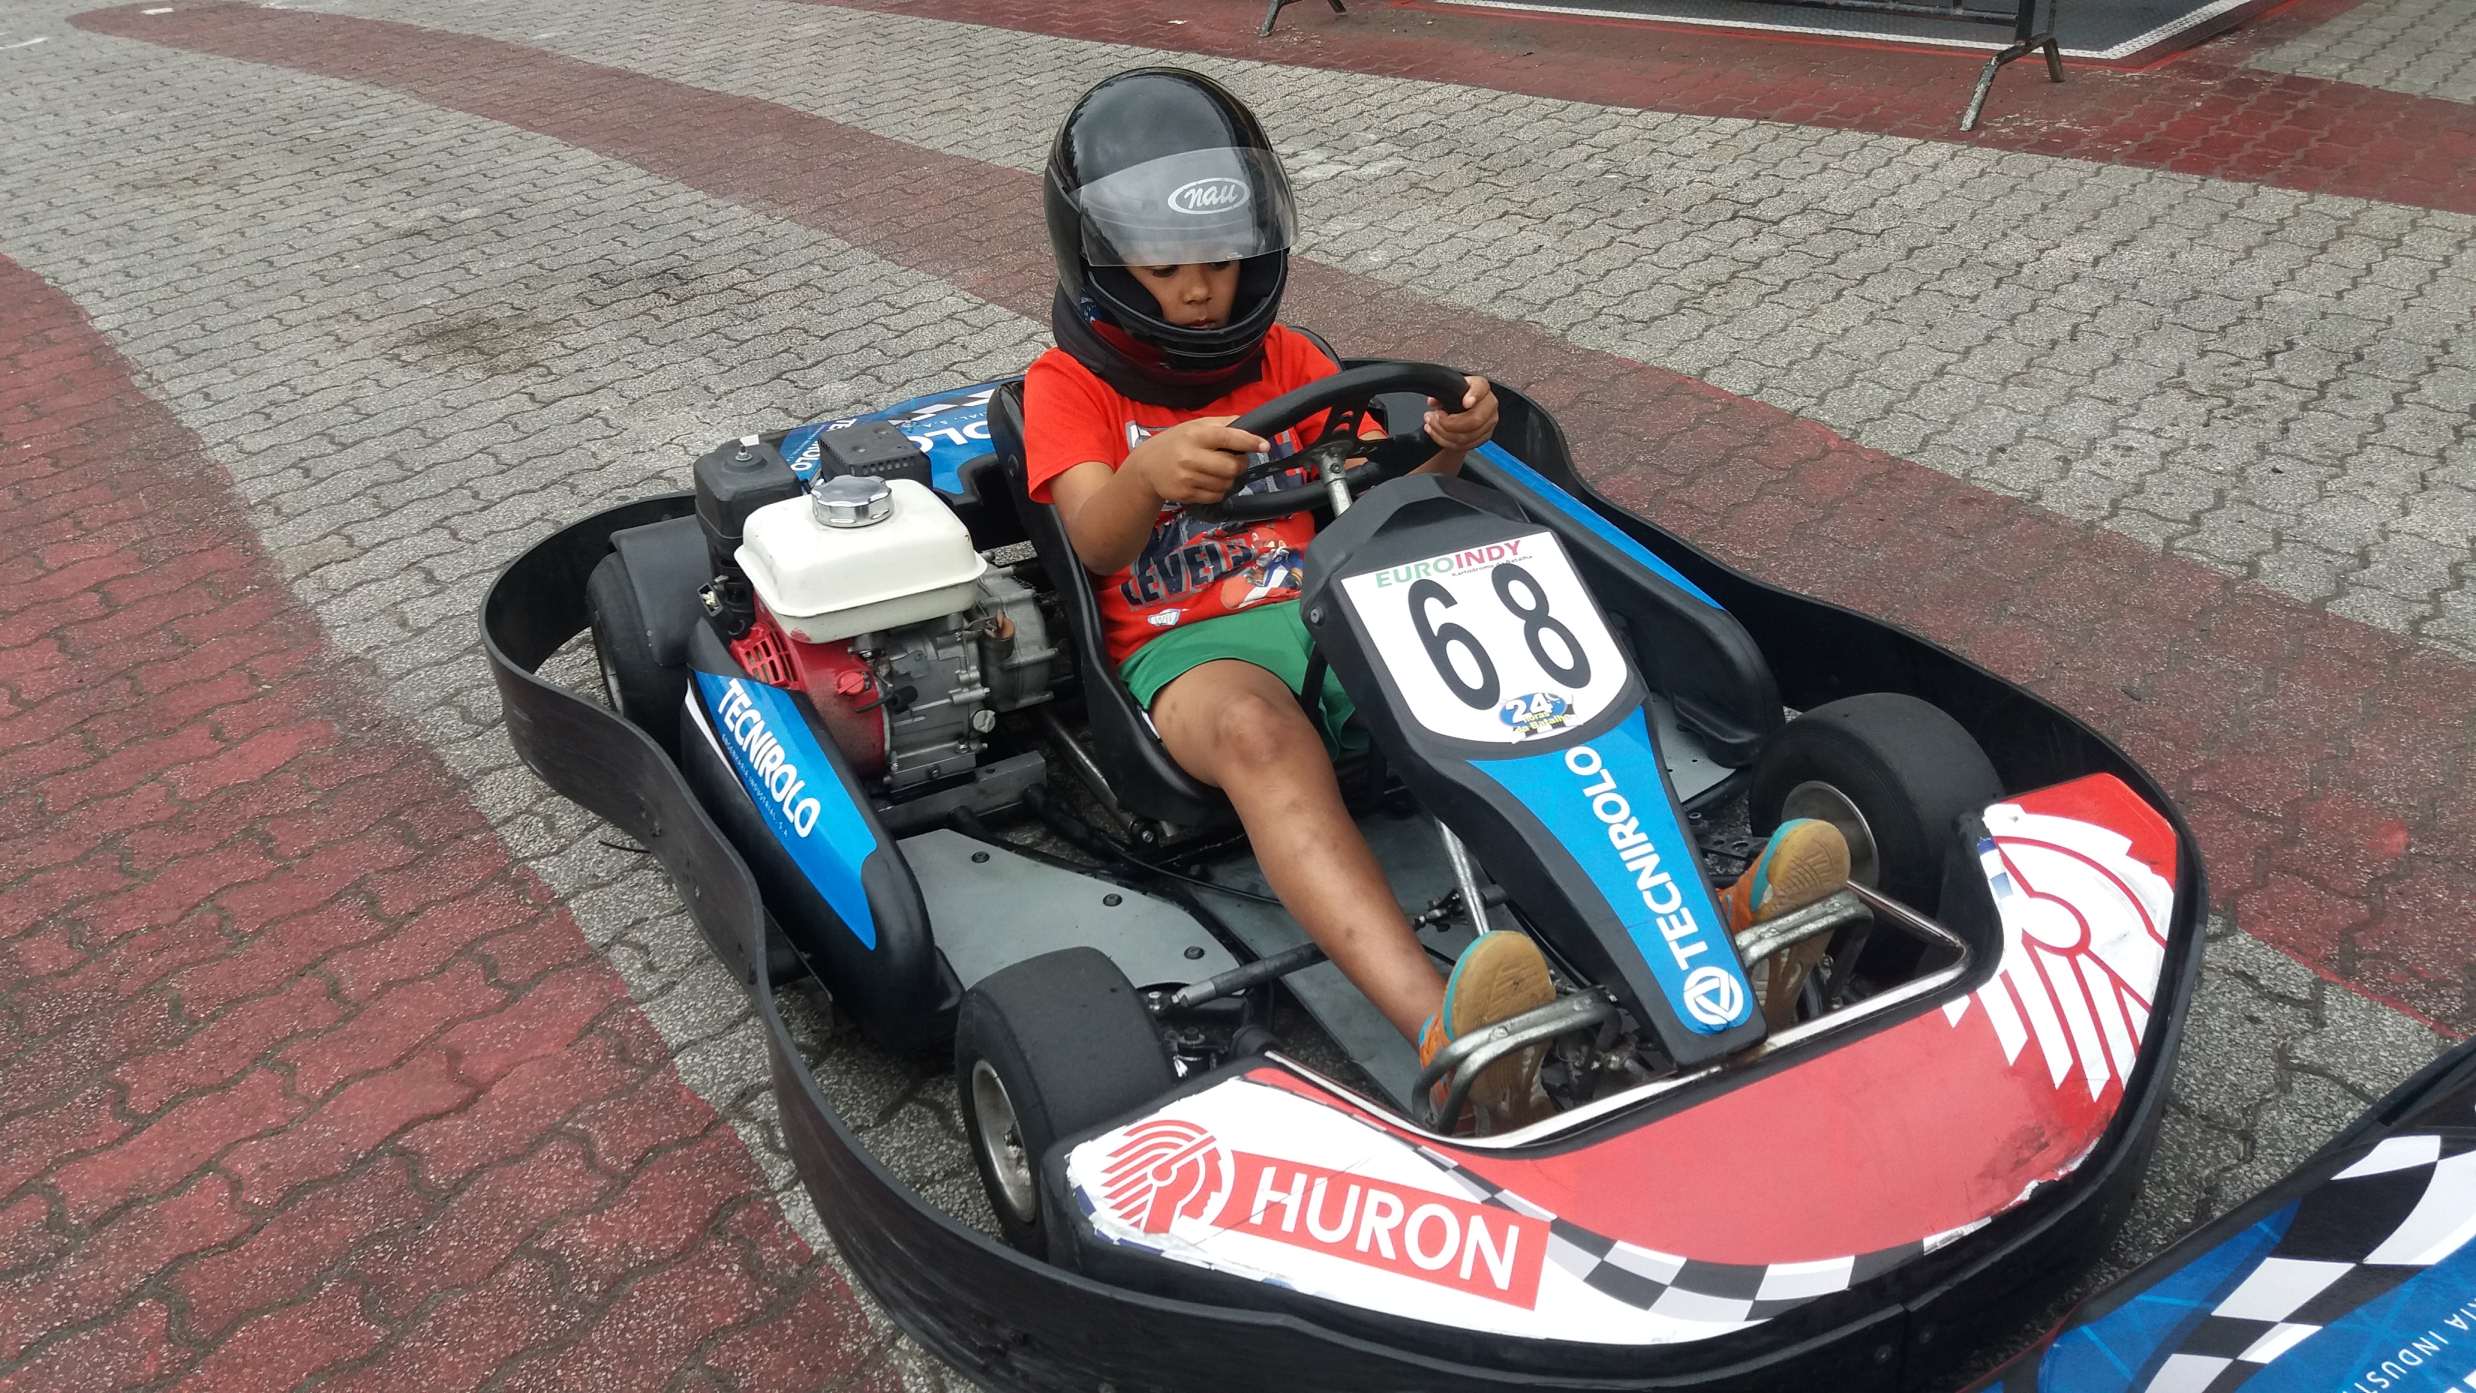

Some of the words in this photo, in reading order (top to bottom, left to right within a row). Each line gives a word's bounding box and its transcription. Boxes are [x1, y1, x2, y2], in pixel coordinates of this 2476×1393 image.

[1375, 540, 1521, 588] EUROINDY
[1408, 564, 1592, 710] 68
[718, 678, 821, 838] TECNIROLO
[1505, 693, 1553, 723] 24
[1565, 745, 1709, 971] TECNIROLO
[1251, 1166, 1520, 1291] HURON
